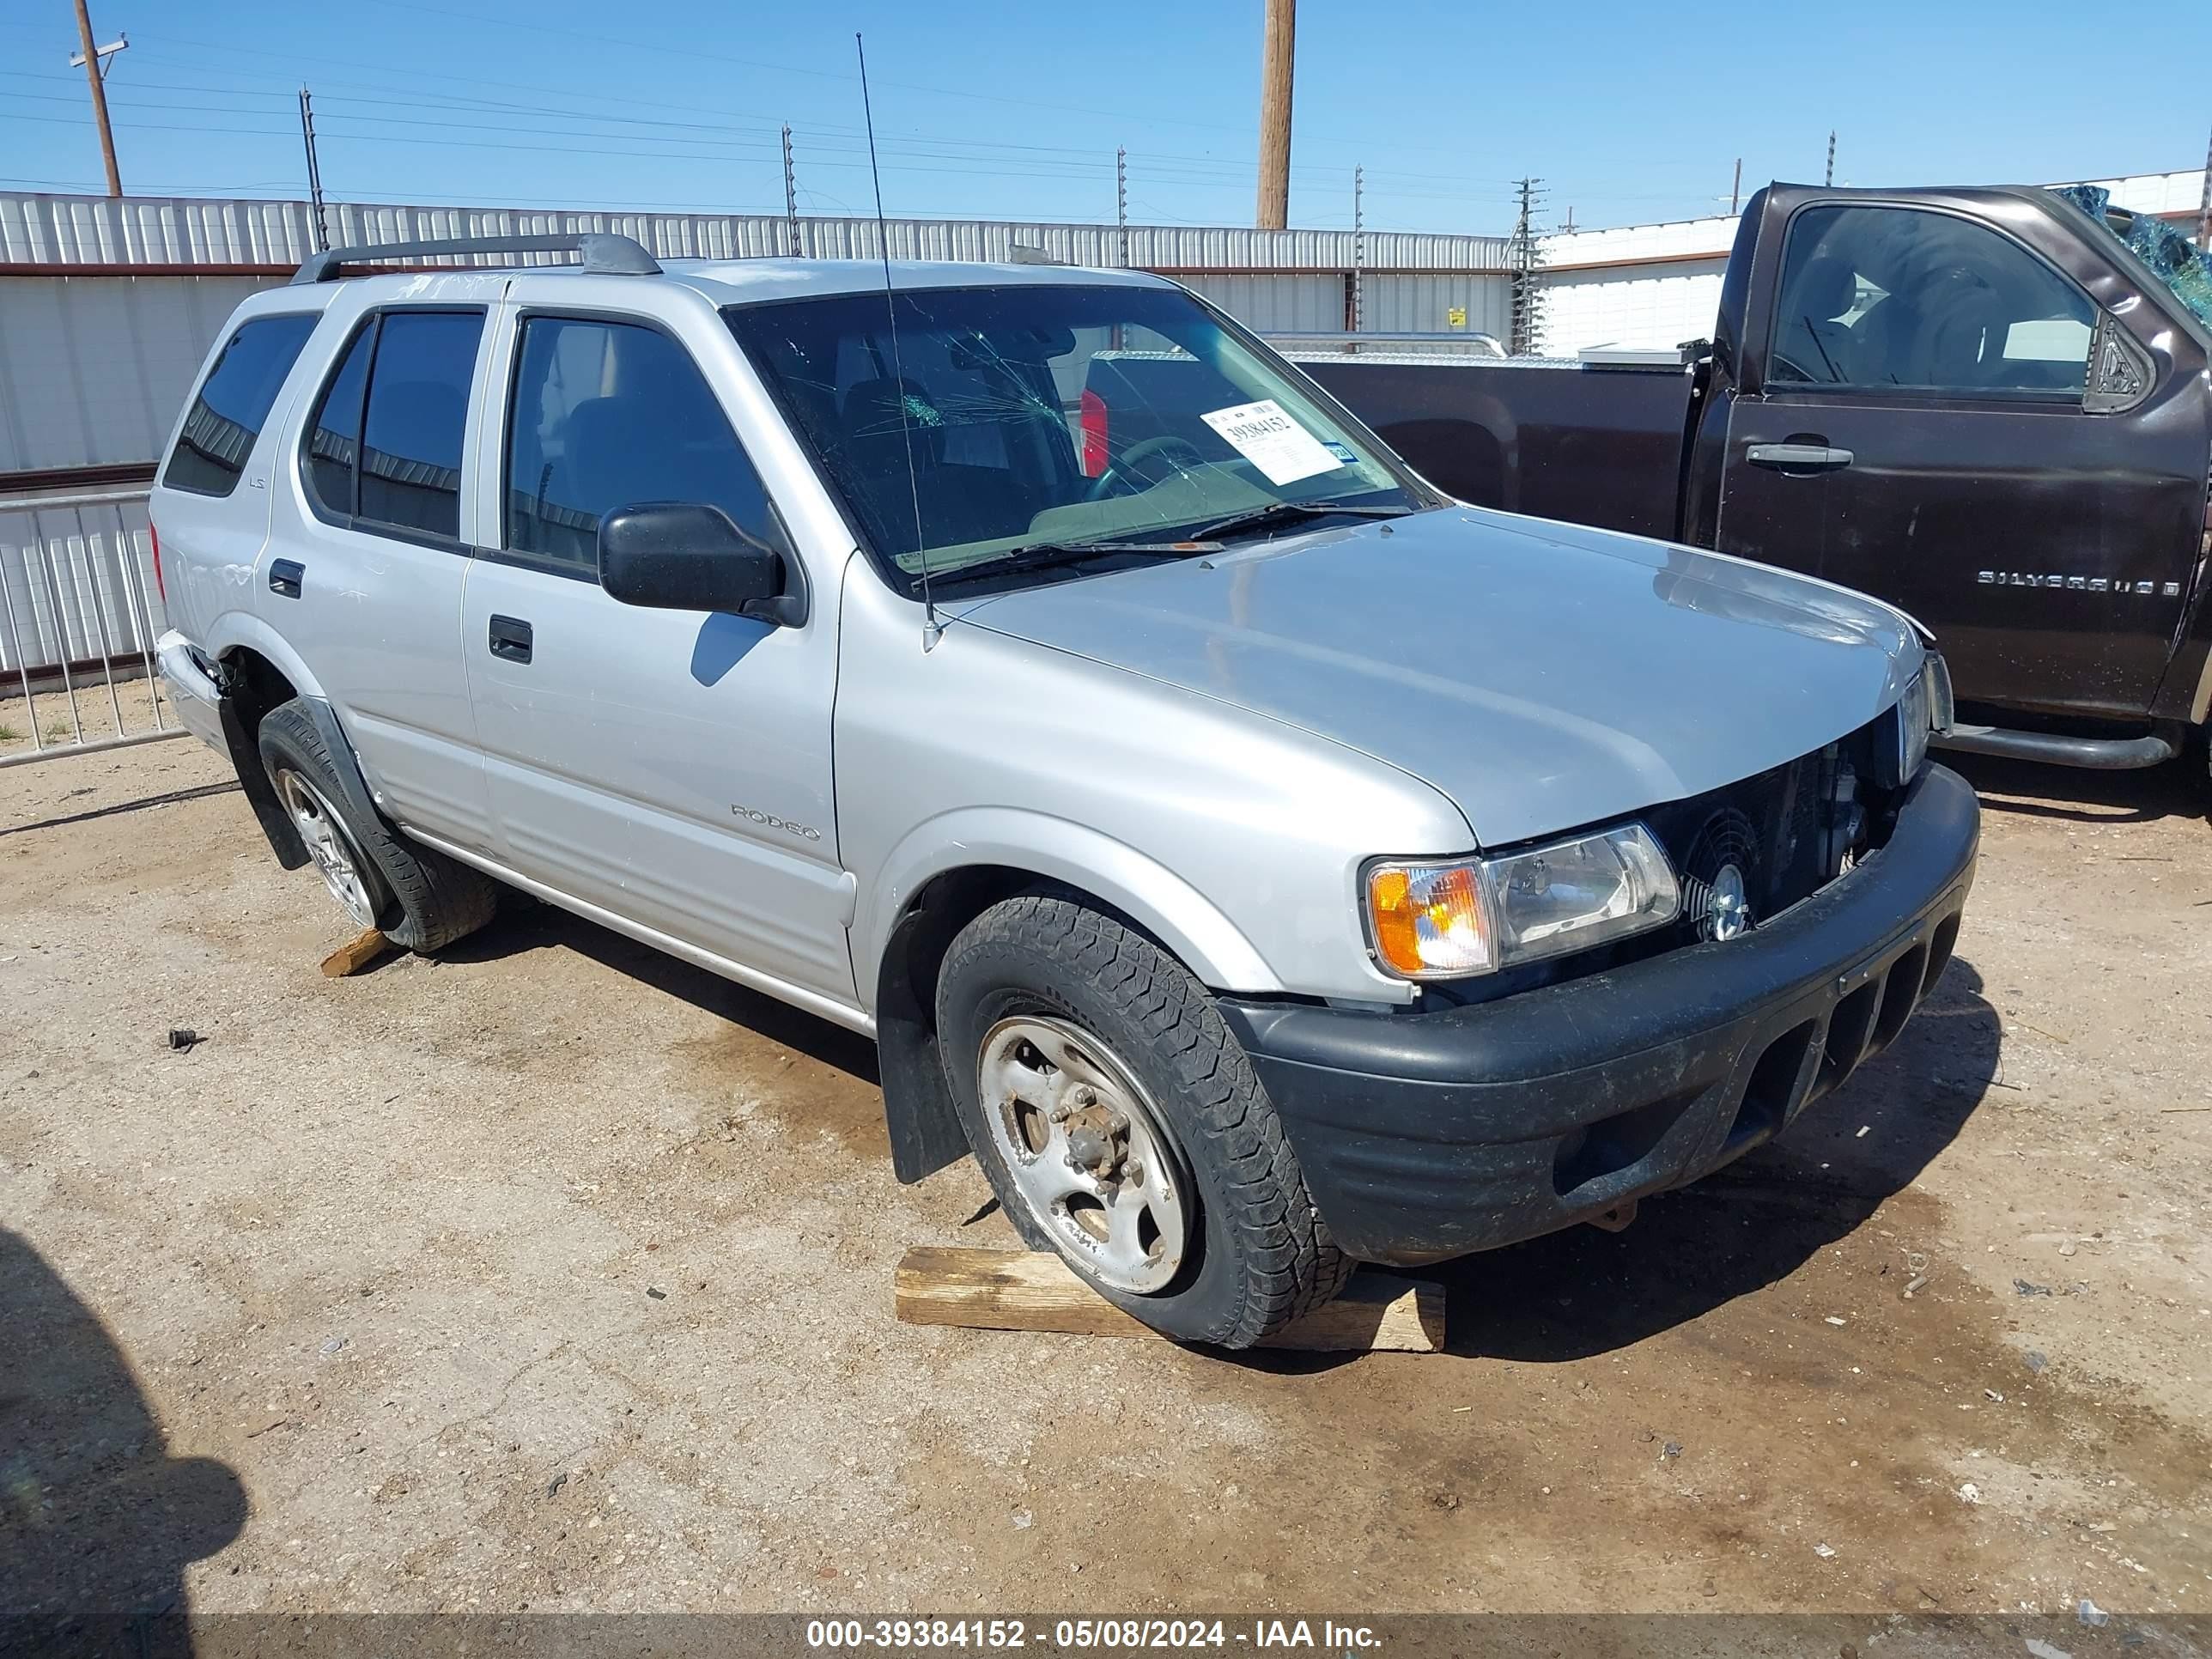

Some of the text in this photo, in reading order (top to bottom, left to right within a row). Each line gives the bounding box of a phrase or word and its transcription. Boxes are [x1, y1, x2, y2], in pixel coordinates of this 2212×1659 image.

[1226, 416, 1291, 441] 39384152
[249, 476, 266, 489] LS
[1978, 570, 2154, 594] SILVERAO
[731, 803, 821, 842] RODEO
